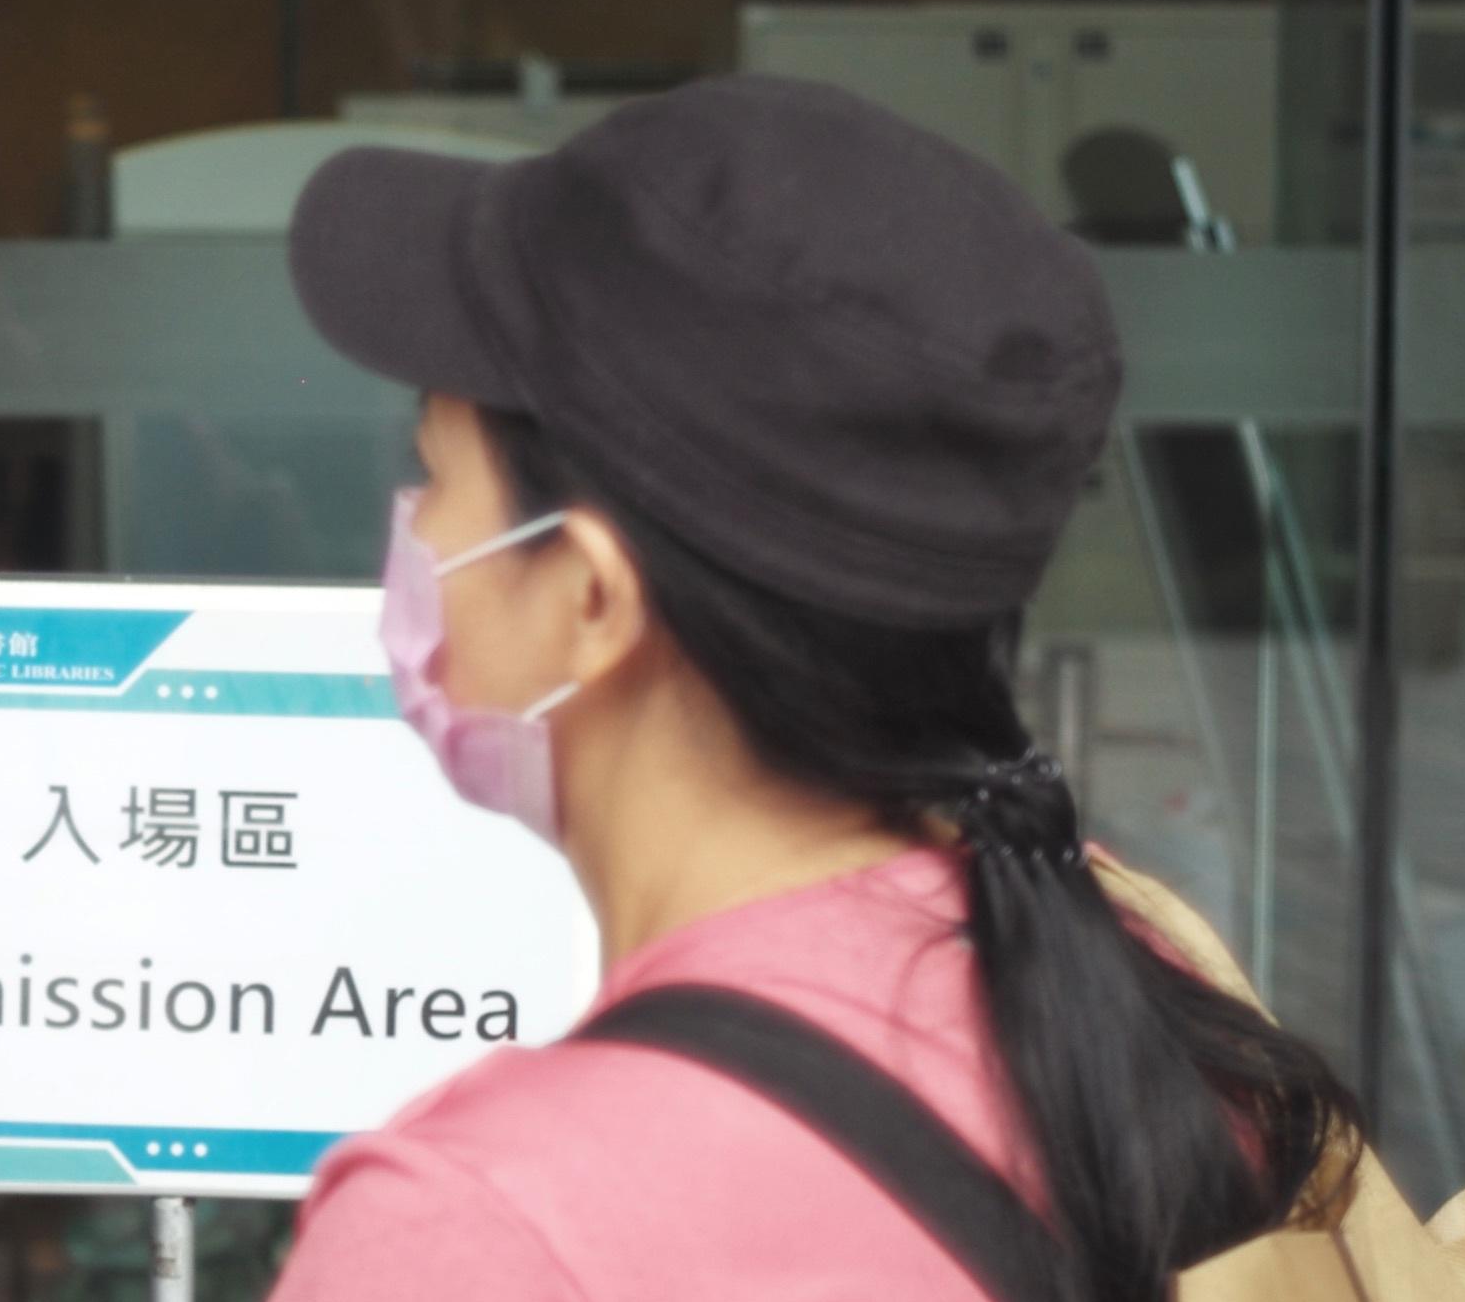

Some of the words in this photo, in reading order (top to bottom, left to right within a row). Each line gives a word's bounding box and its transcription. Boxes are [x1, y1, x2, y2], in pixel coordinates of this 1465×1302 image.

[11, 663, 115, 682] LIBRARIES
[21, 784, 300, 870] 入場區
[309, 965, 521, 1042] Area
